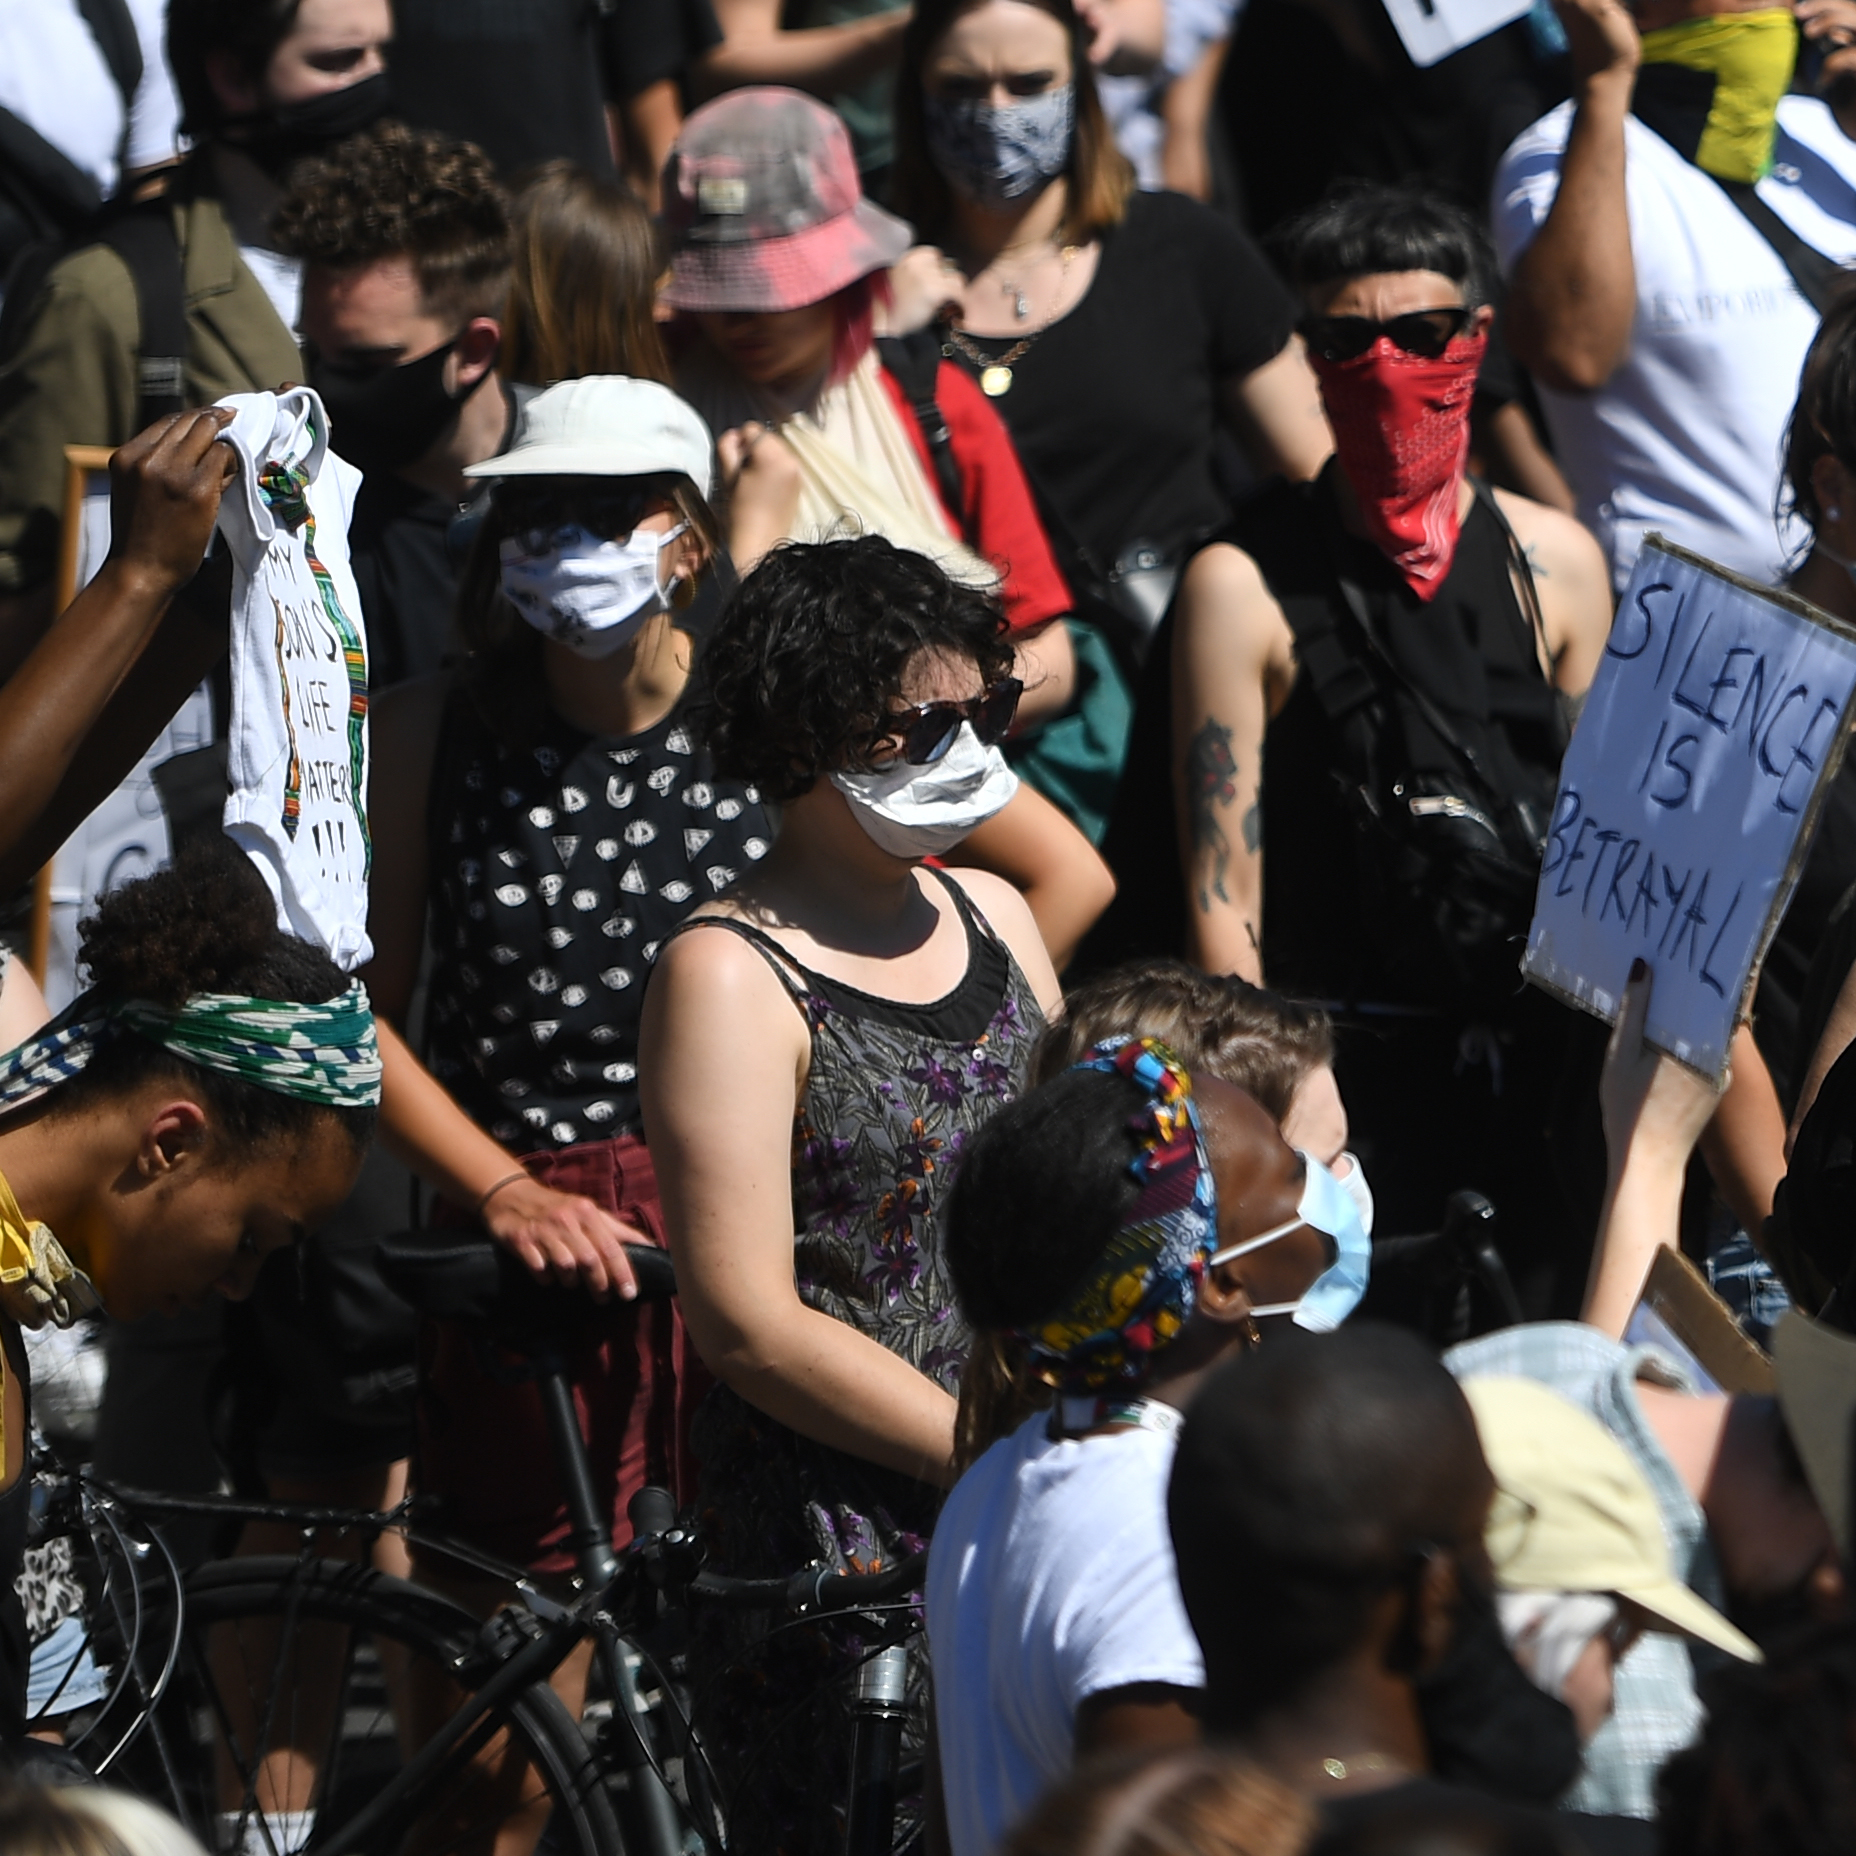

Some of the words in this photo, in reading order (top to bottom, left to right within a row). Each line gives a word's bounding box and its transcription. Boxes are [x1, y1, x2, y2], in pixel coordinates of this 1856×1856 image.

[267, 544, 297, 586] MY
[296, 674, 337, 738] LIFE
[1605, 583, 1839, 816] SILENCE
[1638, 720, 1700, 809] IS
[1540, 790, 1745, 1000] BETRAYAL
